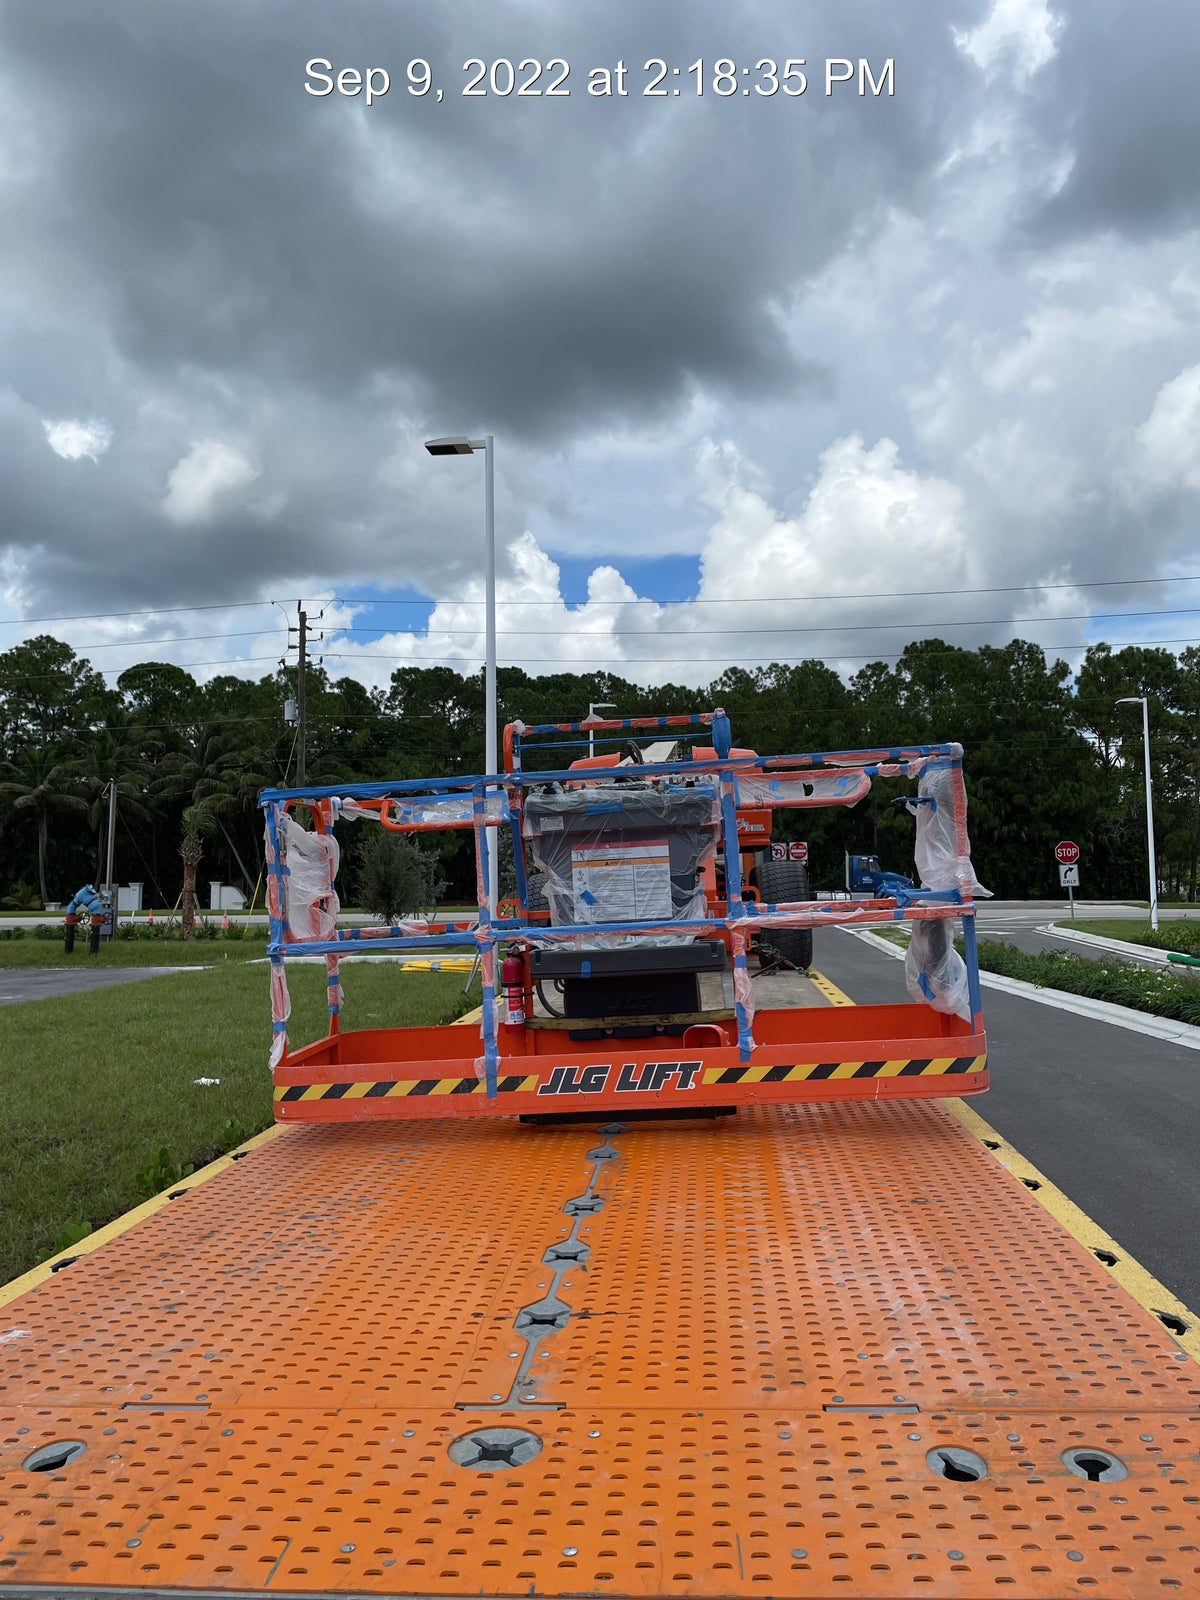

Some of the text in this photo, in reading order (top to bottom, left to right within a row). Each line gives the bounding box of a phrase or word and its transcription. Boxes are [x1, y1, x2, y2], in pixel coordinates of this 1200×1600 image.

[1057, 847, 1077, 857] STOP
[537, 1061, 703, 1096] JLG LIFT
